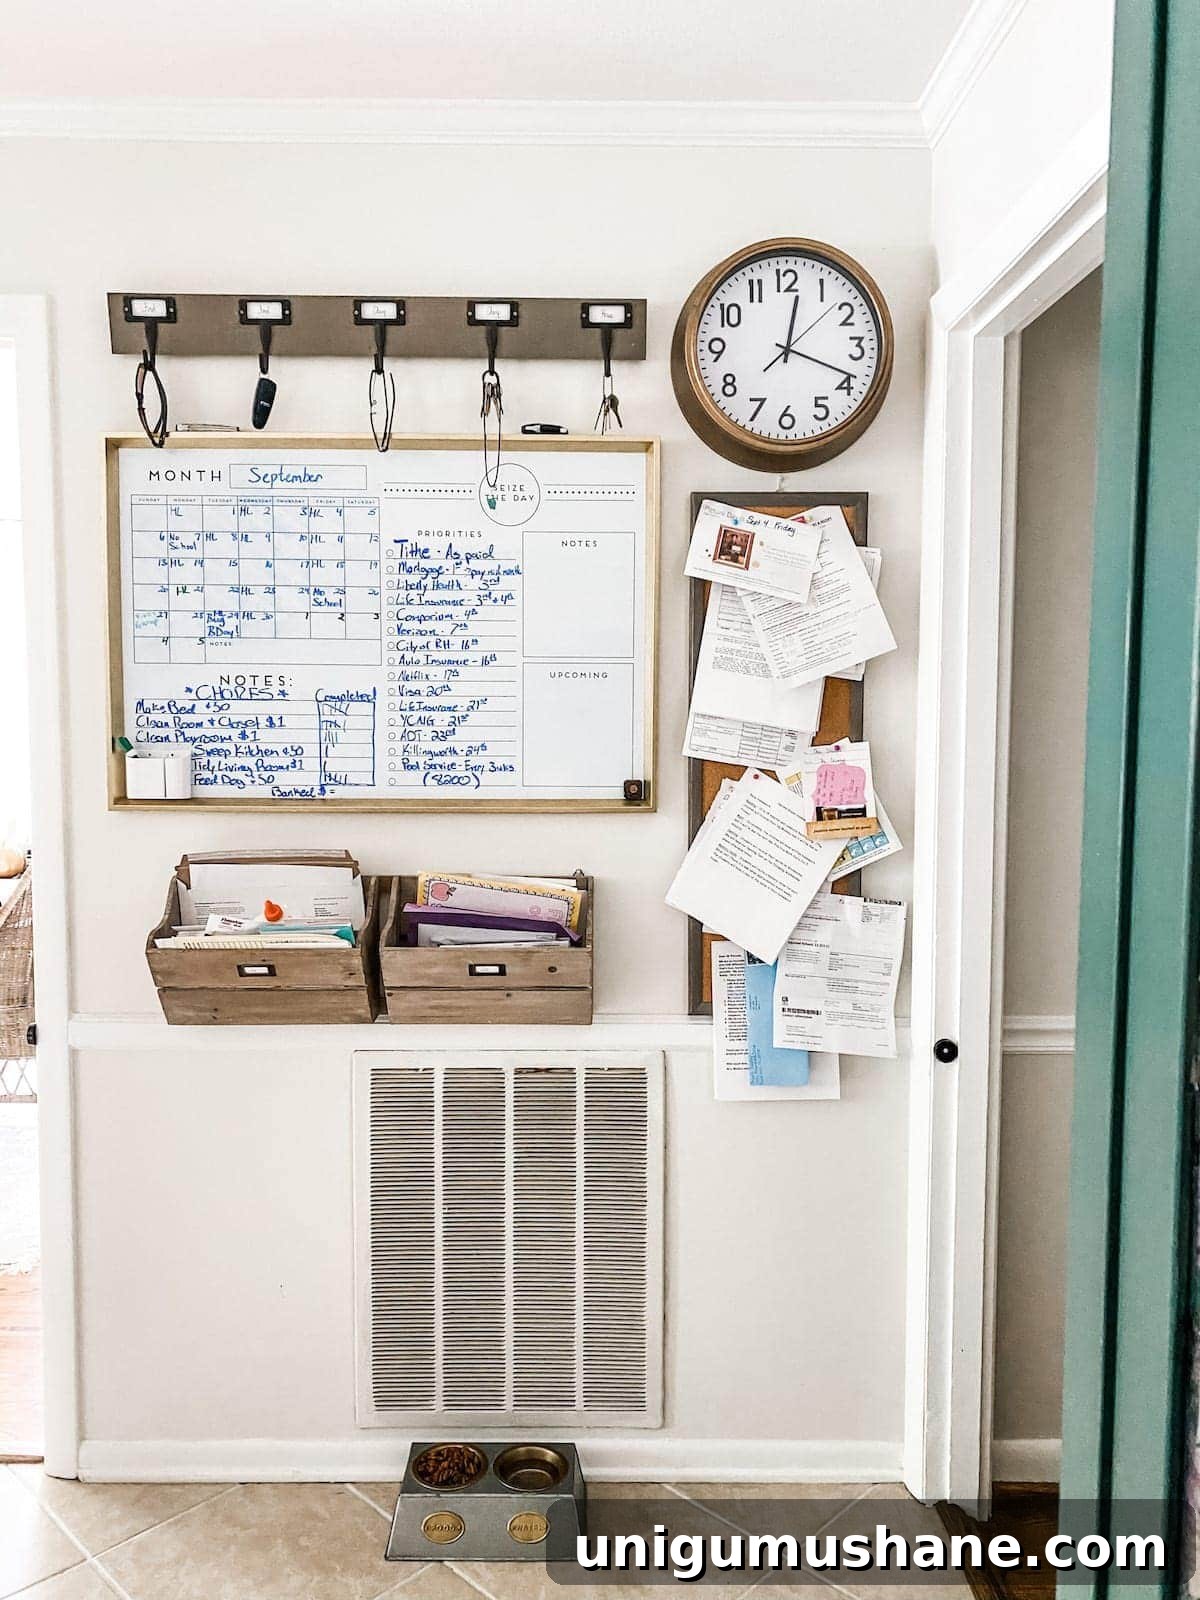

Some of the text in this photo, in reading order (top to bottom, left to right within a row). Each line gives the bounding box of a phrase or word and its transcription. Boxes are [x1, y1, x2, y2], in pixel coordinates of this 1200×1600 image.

[776, 269, 799, 292] 12
[749, 279, 762, 303] 11
[818, 278, 824, 302] 1
[720, 303, 742, 328] 10
[838, 302, 855, 326] 2
[708, 337, 726, 362] 9
[848, 336, 865, 361] 3
[722, 373, 737, 398] 8
[834, 374, 854, 396] 4
[749, 397, 768, 422] 7
[813, 396, 830, 421] 5
[778, 405, 796, 430] 6
[149, 470, 222, 482] MONTH
[248, 465, 324, 489] September
[493, 484, 525, 492] SEIZE
[485, 494, 535, 502] THE DAY
[170, 507, 184, 517] HL
[240, 506, 271, 516] HL 2
[309, 507, 342, 518] HL 4
[746, 515, 761, 526] Sept
[774, 522, 796, 537] Friday
[160, 531, 165, 540] 6
[195, 532, 200, 540] 7
[206, 533, 218, 541] HL
[265, 533, 271, 542] 9
[310, 534, 325, 544] HL
[370, 533, 379, 543] 12
[418, 530, 482, 538] PRIORITIES
[168, 541, 196, 550] School
[446, 542, 460, 560] As
[465, 544, 494, 565] paid
[170, 558, 184, 568] HL
[228, 559, 238, 567] 15
[311, 560, 325, 568] HL
[398, 561, 445, 580] Mortgage
[240, 586, 254, 596] HL
[397, 579, 428, 595] Liberty
[432, 579, 463, 591] Health
[312, 598, 342, 608] School
[416, 593, 464, 606] Insurance
[242, 610, 273, 620] HL 30
[338, 613, 345, 621] 2
[397, 623, 439, 636] Verizon
[162, 638, 168, 646] 4
[197, 637, 205, 645] 5
[396, 640, 418, 653] City
[420, 640, 431, 649] of
[436, 638, 450, 649] RH
[399, 654, 420, 665] Auto
[424, 655, 469, 665] Insurance
[220, 675, 293, 686] NOTES:
[398, 670, 429, 681] Netflix
[316, 687, 376, 702] Completed
[398, 684, 420, 696] Visa
[136, 699, 196, 714] Make Bed
[416, 701, 458, 712] Insurance
[136, 715, 286, 729] Clean Room Closet $1
[136, 729, 260, 744] Clean Playroom $1
[400, 728, 422, 741] ADT
[192, 744, 231, 759] Sweep
[234, 744, 279, 757] Kitchen
[402, 743, 459, 760] Killingworth
[192, 758, 215, 774] Tidy
[218, 760, 254, 777] Living
[256, 759, 289, 771] Room
[401, 758, 420, 770] Pool
[423, 760, 456, 771] Service
[464, 760, 485, 775] Every
[194, 773, 245, 789] Feed Dog
[272, 786, 316, 797] Banked
